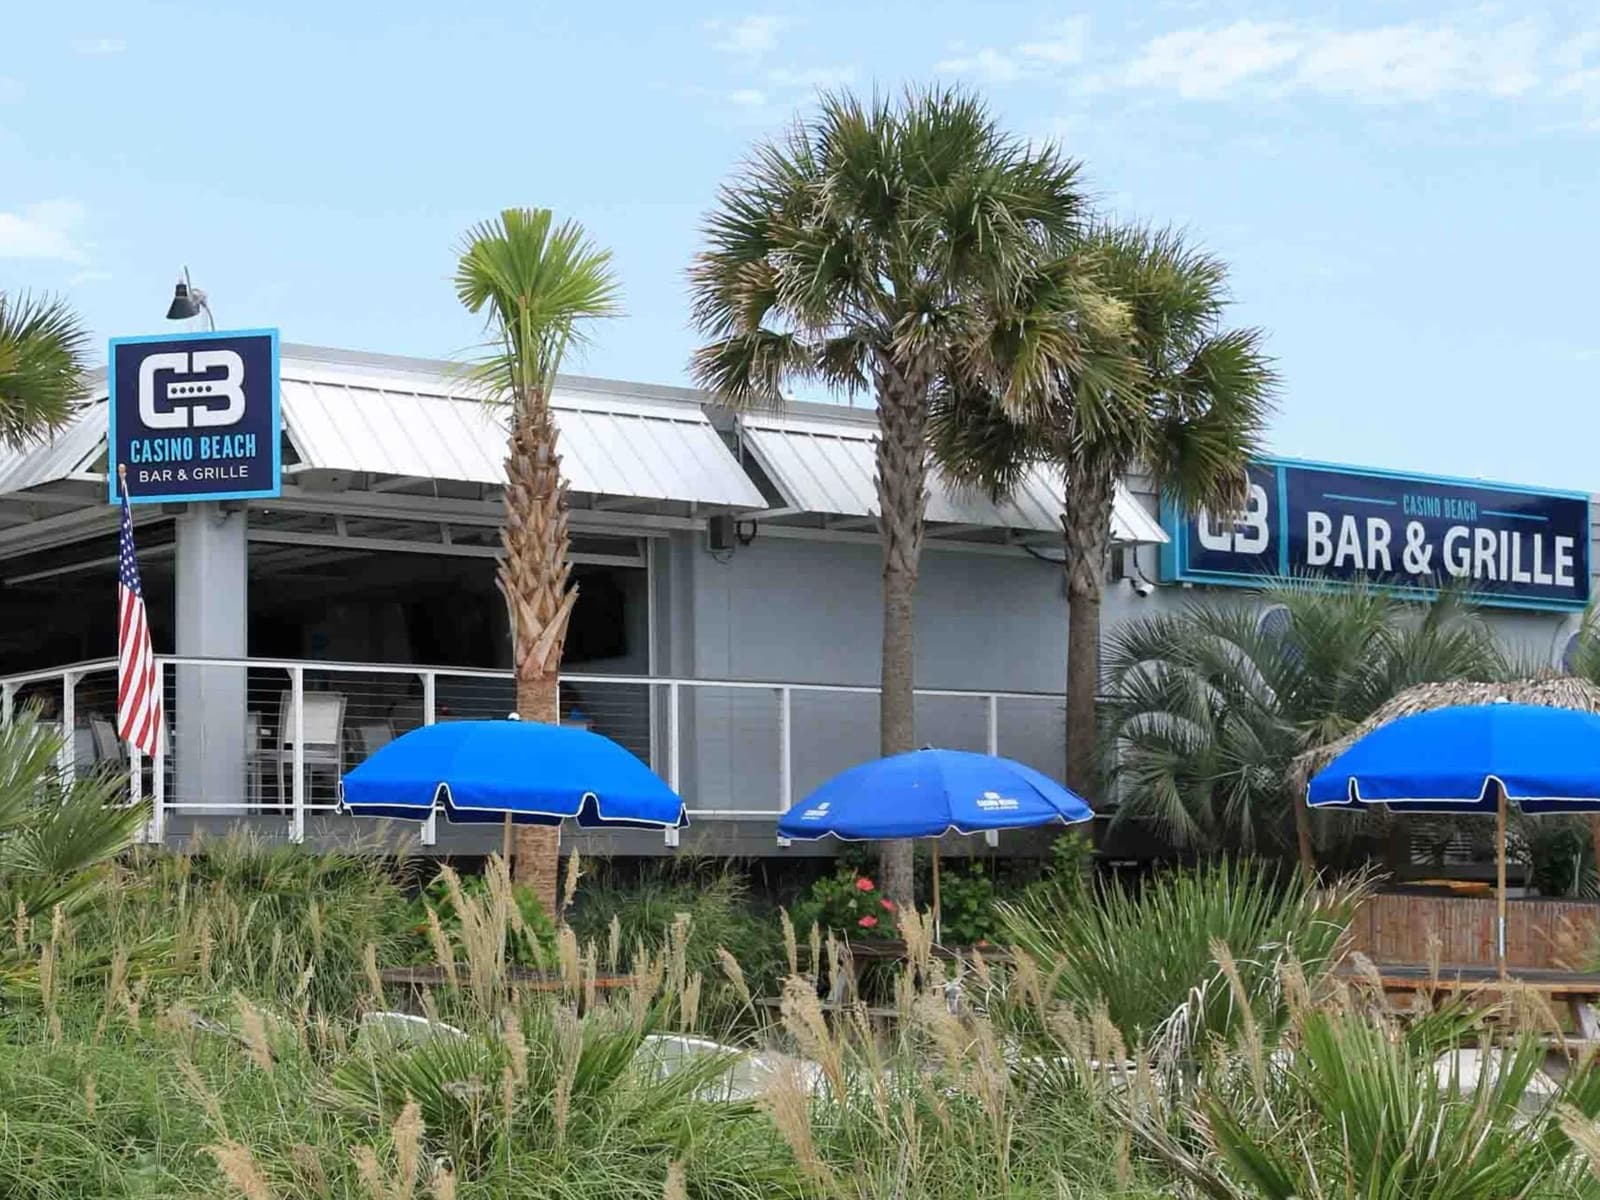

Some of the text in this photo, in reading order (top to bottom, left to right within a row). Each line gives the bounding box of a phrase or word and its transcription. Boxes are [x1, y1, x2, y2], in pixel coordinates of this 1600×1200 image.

[138, 349, 246, 429] CB
[130, 433, 256, 464] CASINO BEACH
[139, 465, 249, 483] BAR & GRILLE
[1403, 494, 1478, 522] CASINO BEACH
[1306, 511, 1575, 588] BAR & GRILLE
